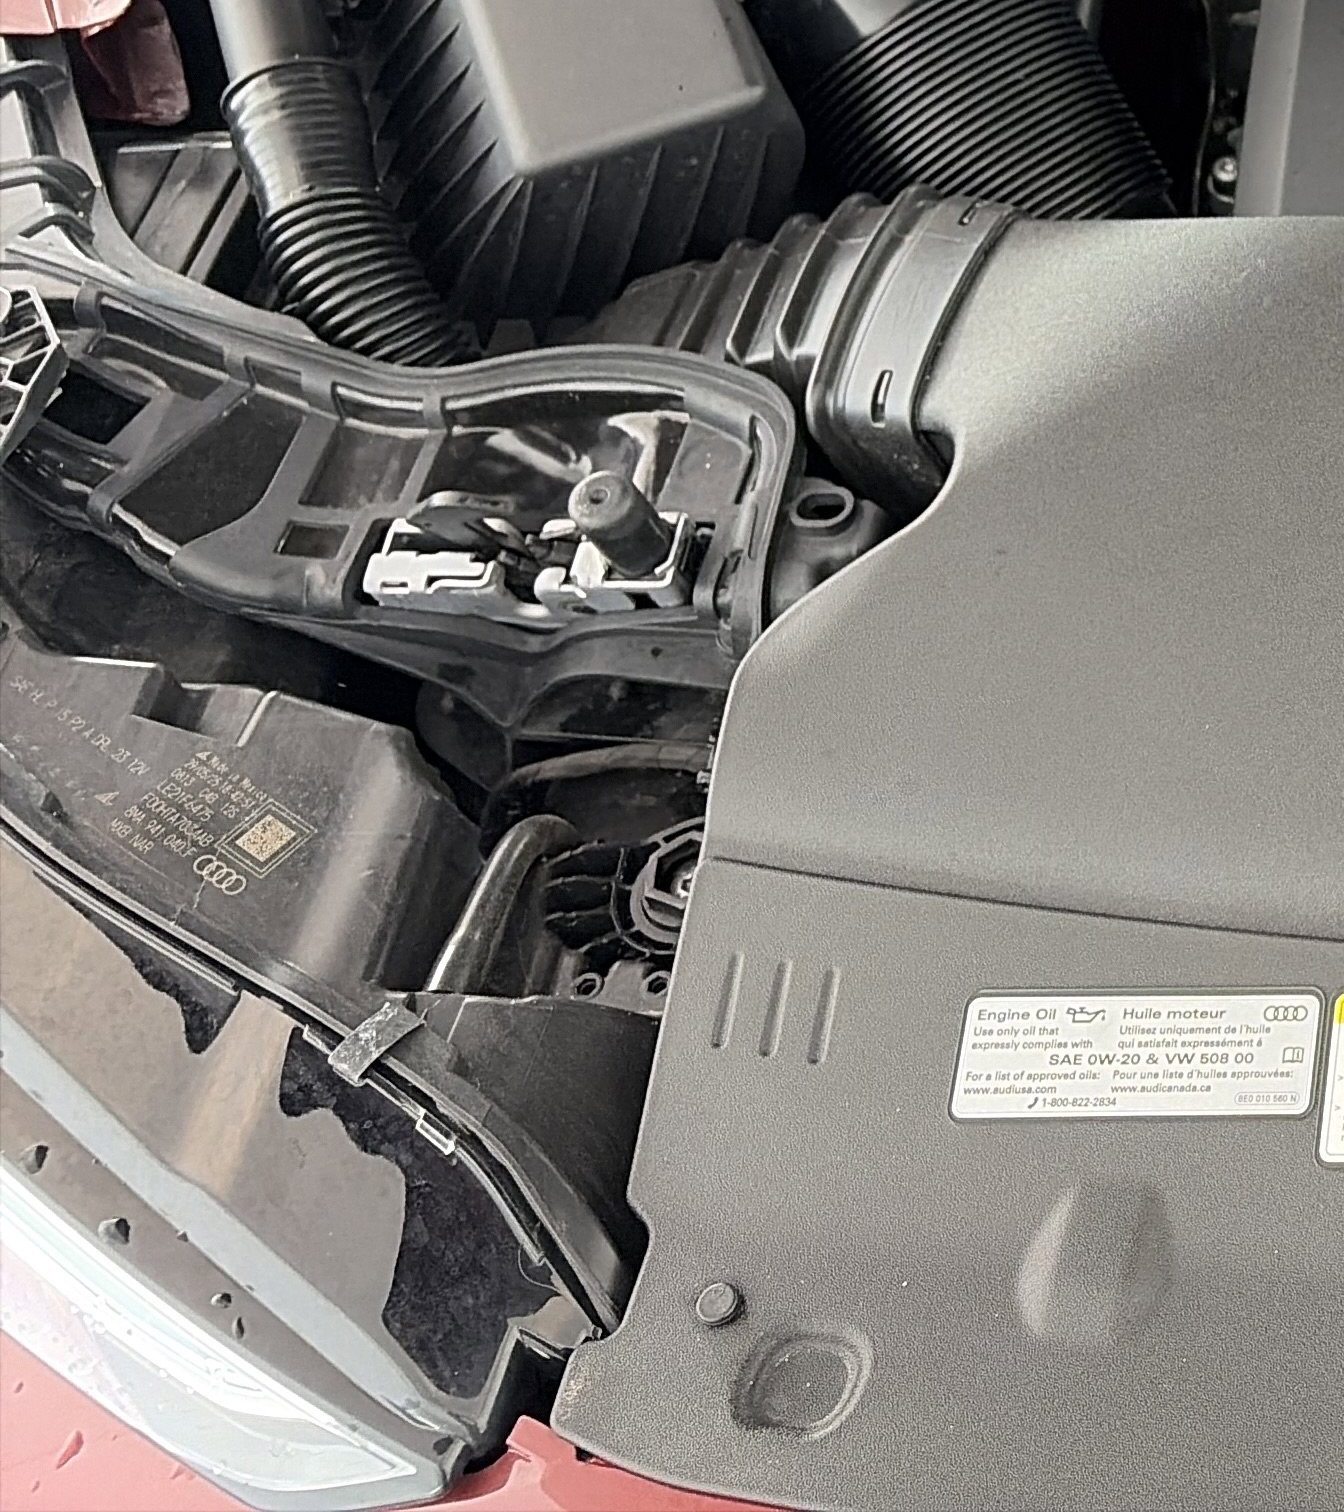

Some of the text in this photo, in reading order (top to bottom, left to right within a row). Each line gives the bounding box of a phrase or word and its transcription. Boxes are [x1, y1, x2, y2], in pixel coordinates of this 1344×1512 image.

[977, 1009, 1056, 1023] Engine Oil
[1122, 1008, 1226, 1020] Huile moteur
[973, 1026, 1059, 1038] Use only oil that
[1119, 1025, 1156, 1035] Utilisez
[1159, 1025, 1221, 1036] uniquement
[1224, 1024, 1237, 1034] de
[971, 1039, 1093, 1051] expressly complies with
[1118, 1038, 1135, 1050] qui
[1137, 1038, 1178, 1048] satisfait
[1180, 1038, 1254, 1049] expressément
[1049, 1053, 1254, 1065] SAE 0W-20 & VW 508 00
[966, 1071, 982, 1081] For
[995, 1071, 1010, 1081] list
[1013, 1071, 1024, 1081] of
[1026, 1071, 1075, 1082] approved
[1078, 1070, 1100, 1080] oils:
[1113, 1069, 1137, 1079] Pour
[1162, 1069, 1184, 1079] liste
[1230, 1069, 1293, 1080] approuvées:
[963, 1084, 1057, 1095] www.audiusa.com
[1111, 1083, 1211, 1093] www.audicanada.ca
[1042, 1097, 1117, 1107] 1-800-822-2834
[1255, 1094, 1270, 1103] 010
